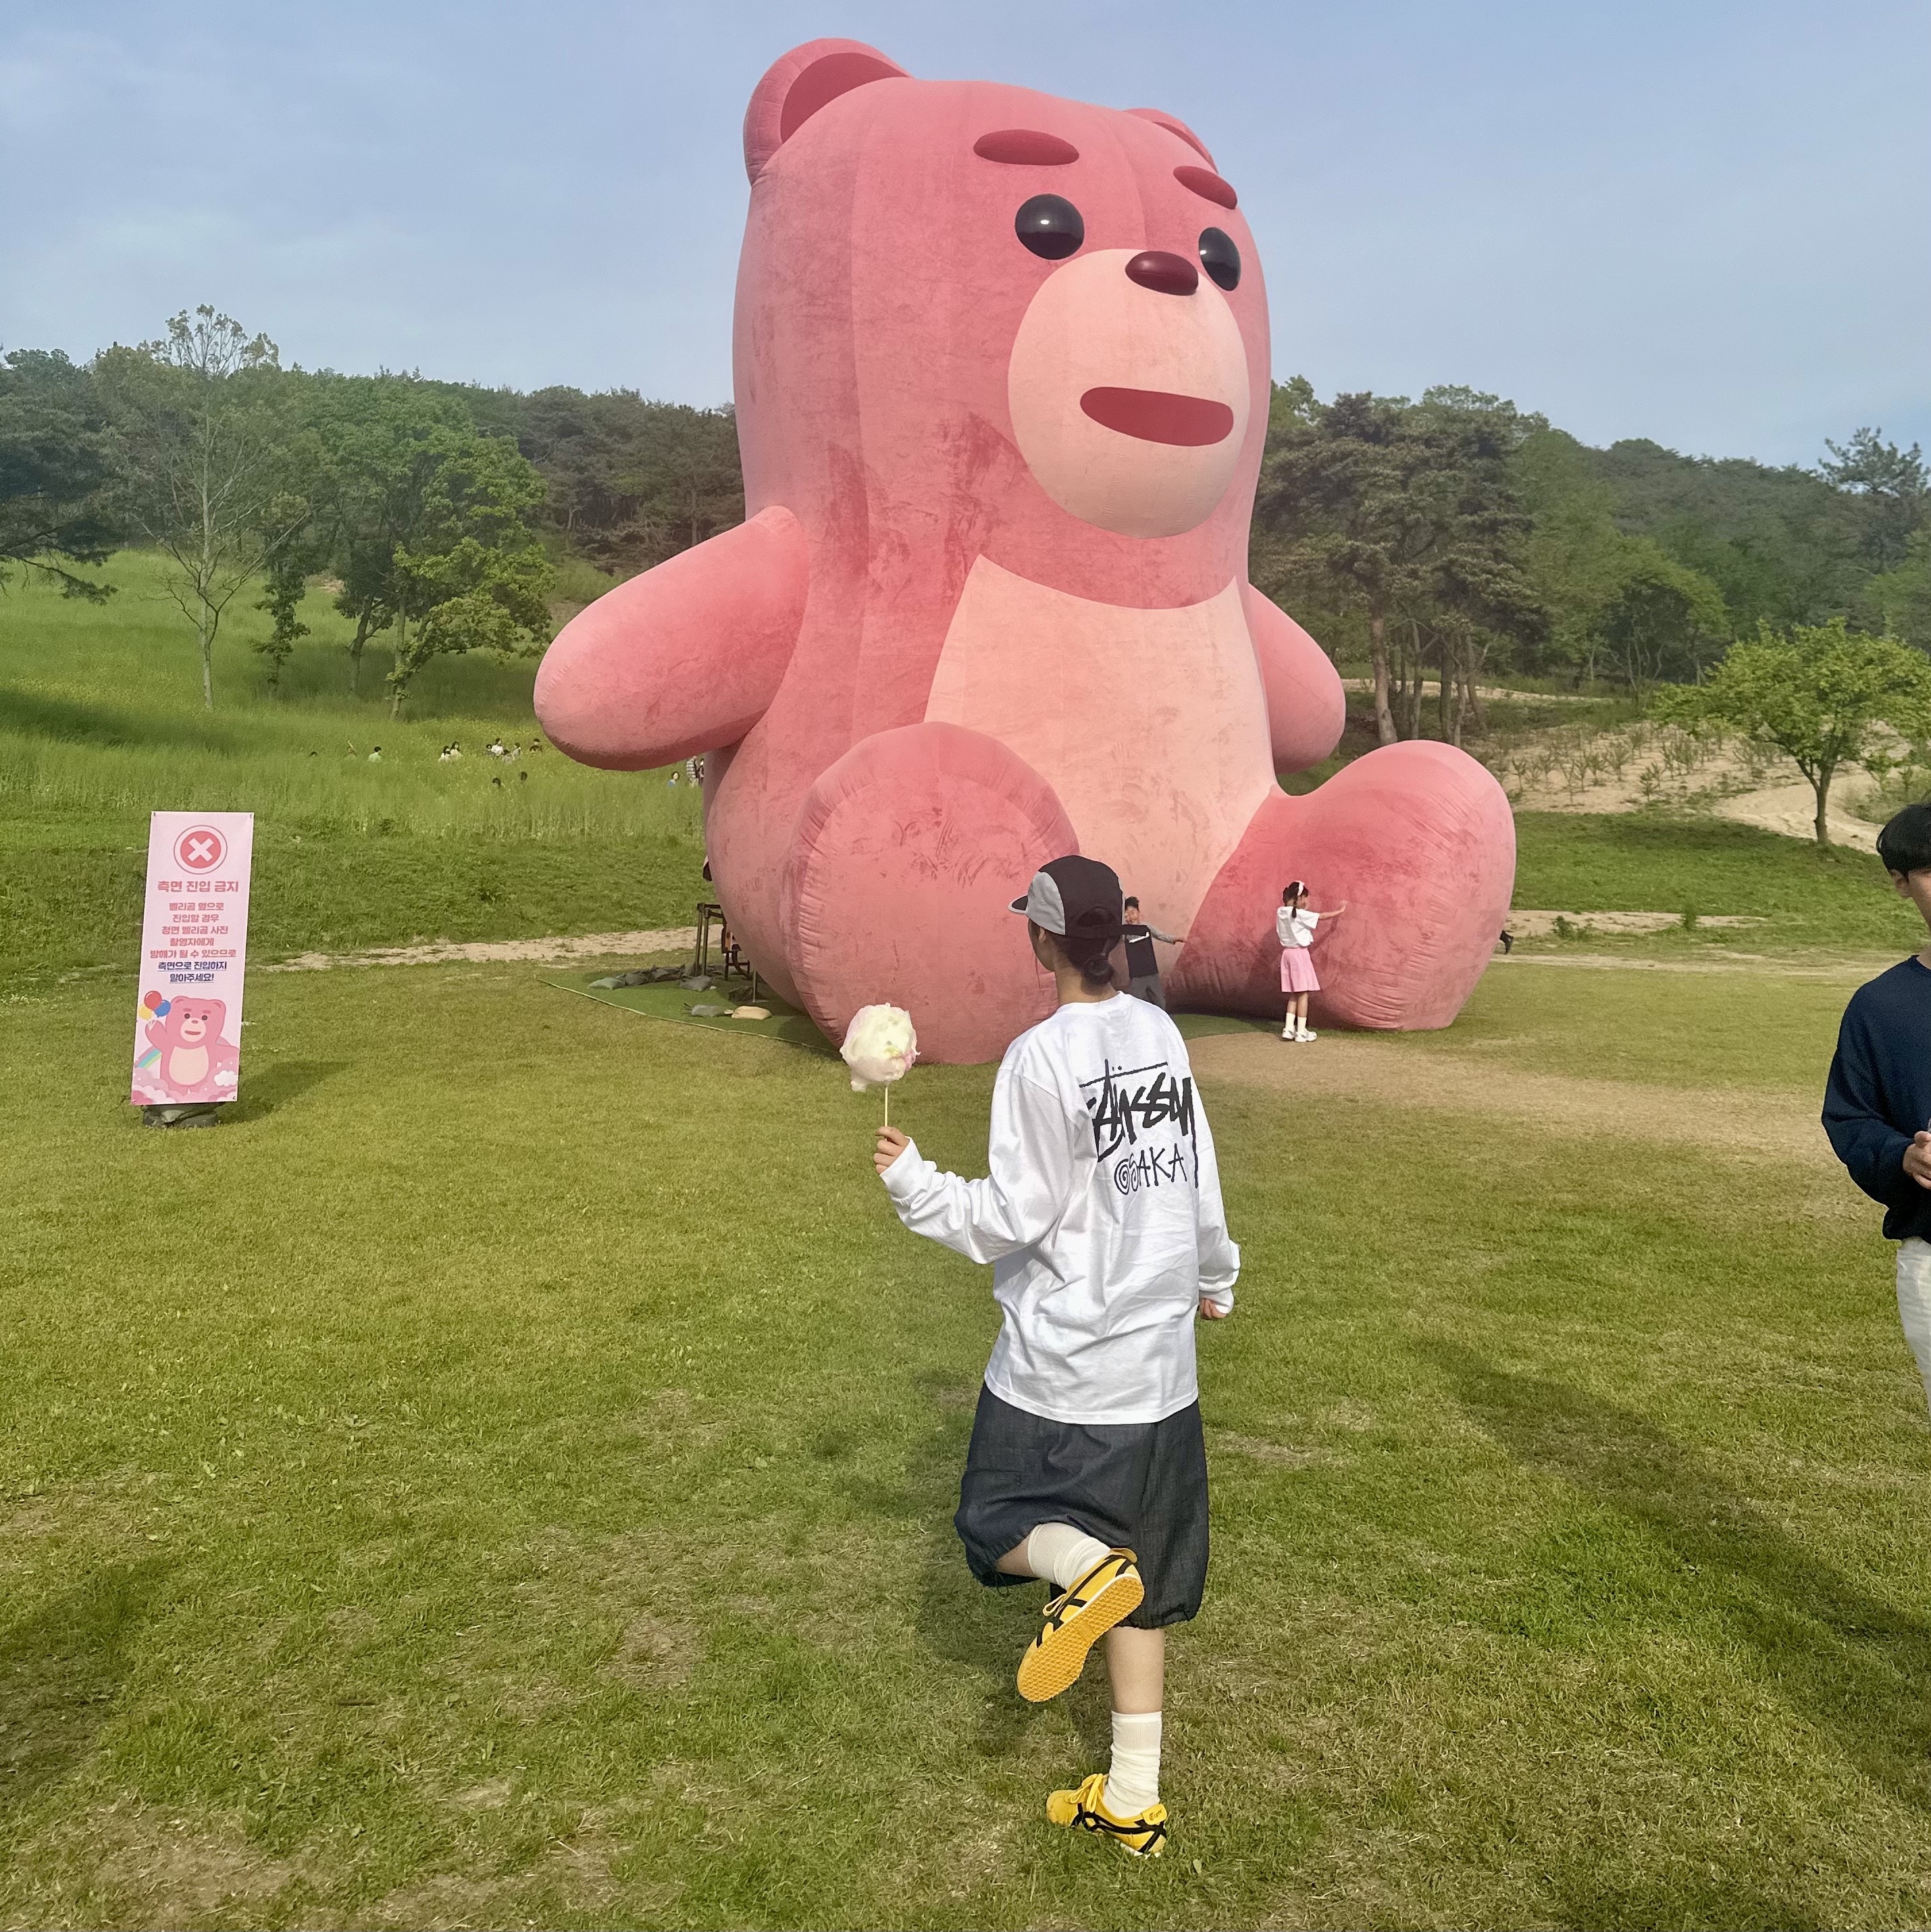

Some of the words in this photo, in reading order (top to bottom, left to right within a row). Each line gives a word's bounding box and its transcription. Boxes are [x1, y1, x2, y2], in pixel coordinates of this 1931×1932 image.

[157, 881, 182, 892] 측면
[186, 881, 211, 892] 진입
[214, 881, 239, 892] 금지
[198, 902, 224, 911] 옆으로
[172, 914, 199, 922] 진입할
[202, 914, 220, 922] 경우
[162, 926, 180, 935] 정면
[210, 925, 228, 935] 사진
[170, 937, 215, 946] 촬영자에게
[150, 949, 177, 959] 방해가
[180, 949, 188, 958] 될
[190, 950, 199, 958] 수
[201, 949, 236, 958] 있으므로
[158, 962, 192, 970] 측면으로
[194, 961, 227, 970] 진입하지
[170, 973, 214, 982] 말아주세요!
